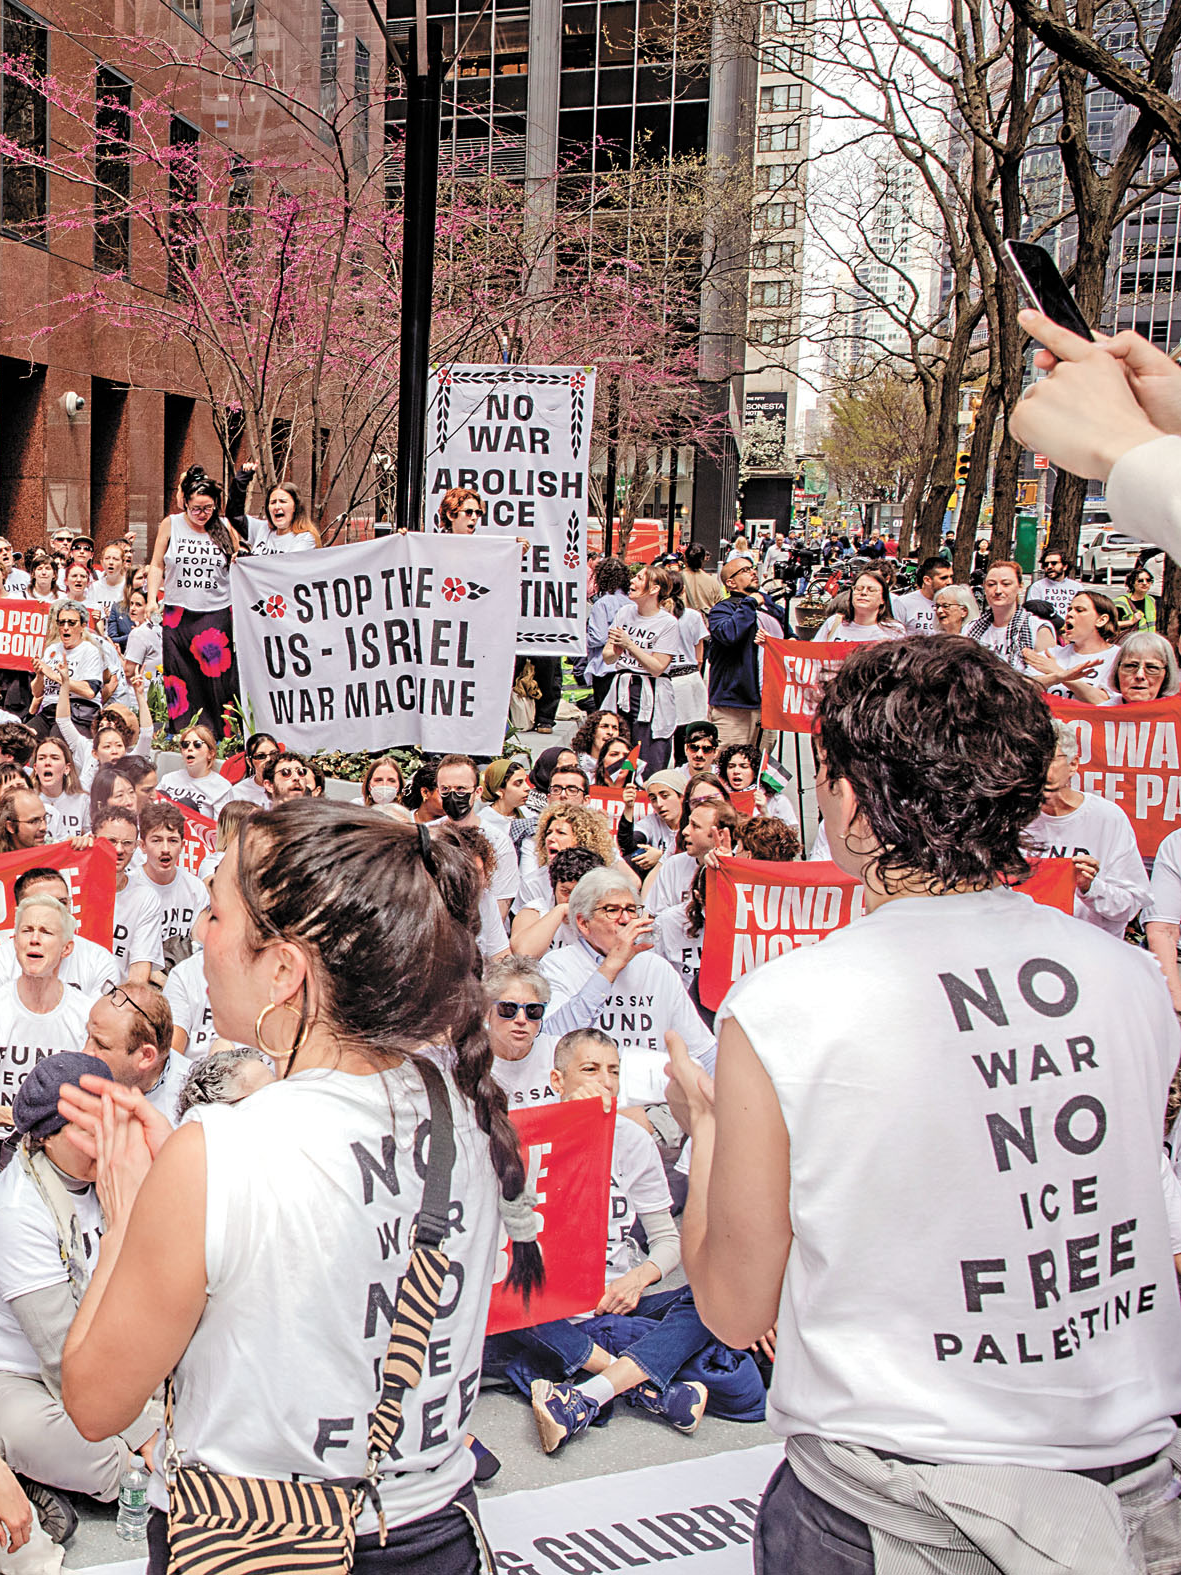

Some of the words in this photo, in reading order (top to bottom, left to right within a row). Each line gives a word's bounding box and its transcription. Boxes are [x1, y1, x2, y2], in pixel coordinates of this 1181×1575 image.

[486, 394, 534, 421] NO
[468, 426, 550, 455] WAR
[431, 468, 583, 499] ABOLISH
[481, 500, 535, 527] ICE
[175, 557, 222, 567] PEOPLE
[177, 546, 222, 556] FUND
[4, 584, 26, 593] UND
[177, 579, 219, 589] BOMBS
[182, 568, 214, 578] NOT
[293, 574, 372, 624] STOP
[381, 567, 434, 611] THE
[8, 611, 47, 635] PEO
[263, 632, 312, 680] US
[268, 684, 335, 726] WAR
[345, 674, 476, 722] MACINE
[1104, 721, 1180, 769] WA
[161, 909, 194, 925] UND
[735, 884, 840, 930] FUND
[630, 995, 654, 1007] SAY
[938, 957, 1080, 1032] NO
[599, 1013, 653, 1032] UND
[971, 1035, 1099, 1090] WAR
[530, 1085, 554, 1100] SA
[986, 1094, 1107, 1172] NO
[1020, 1176, 1099, 1230] ICE
[377, 1200, 467, 1260] WR
[960, 1218, 1139, 1313] FREE
[934, 1283, 1158, 1365] PALESTINE
[373, 1338, 452, 1393] IE
[533, 1497, 761, 1575] GILLIBRA
